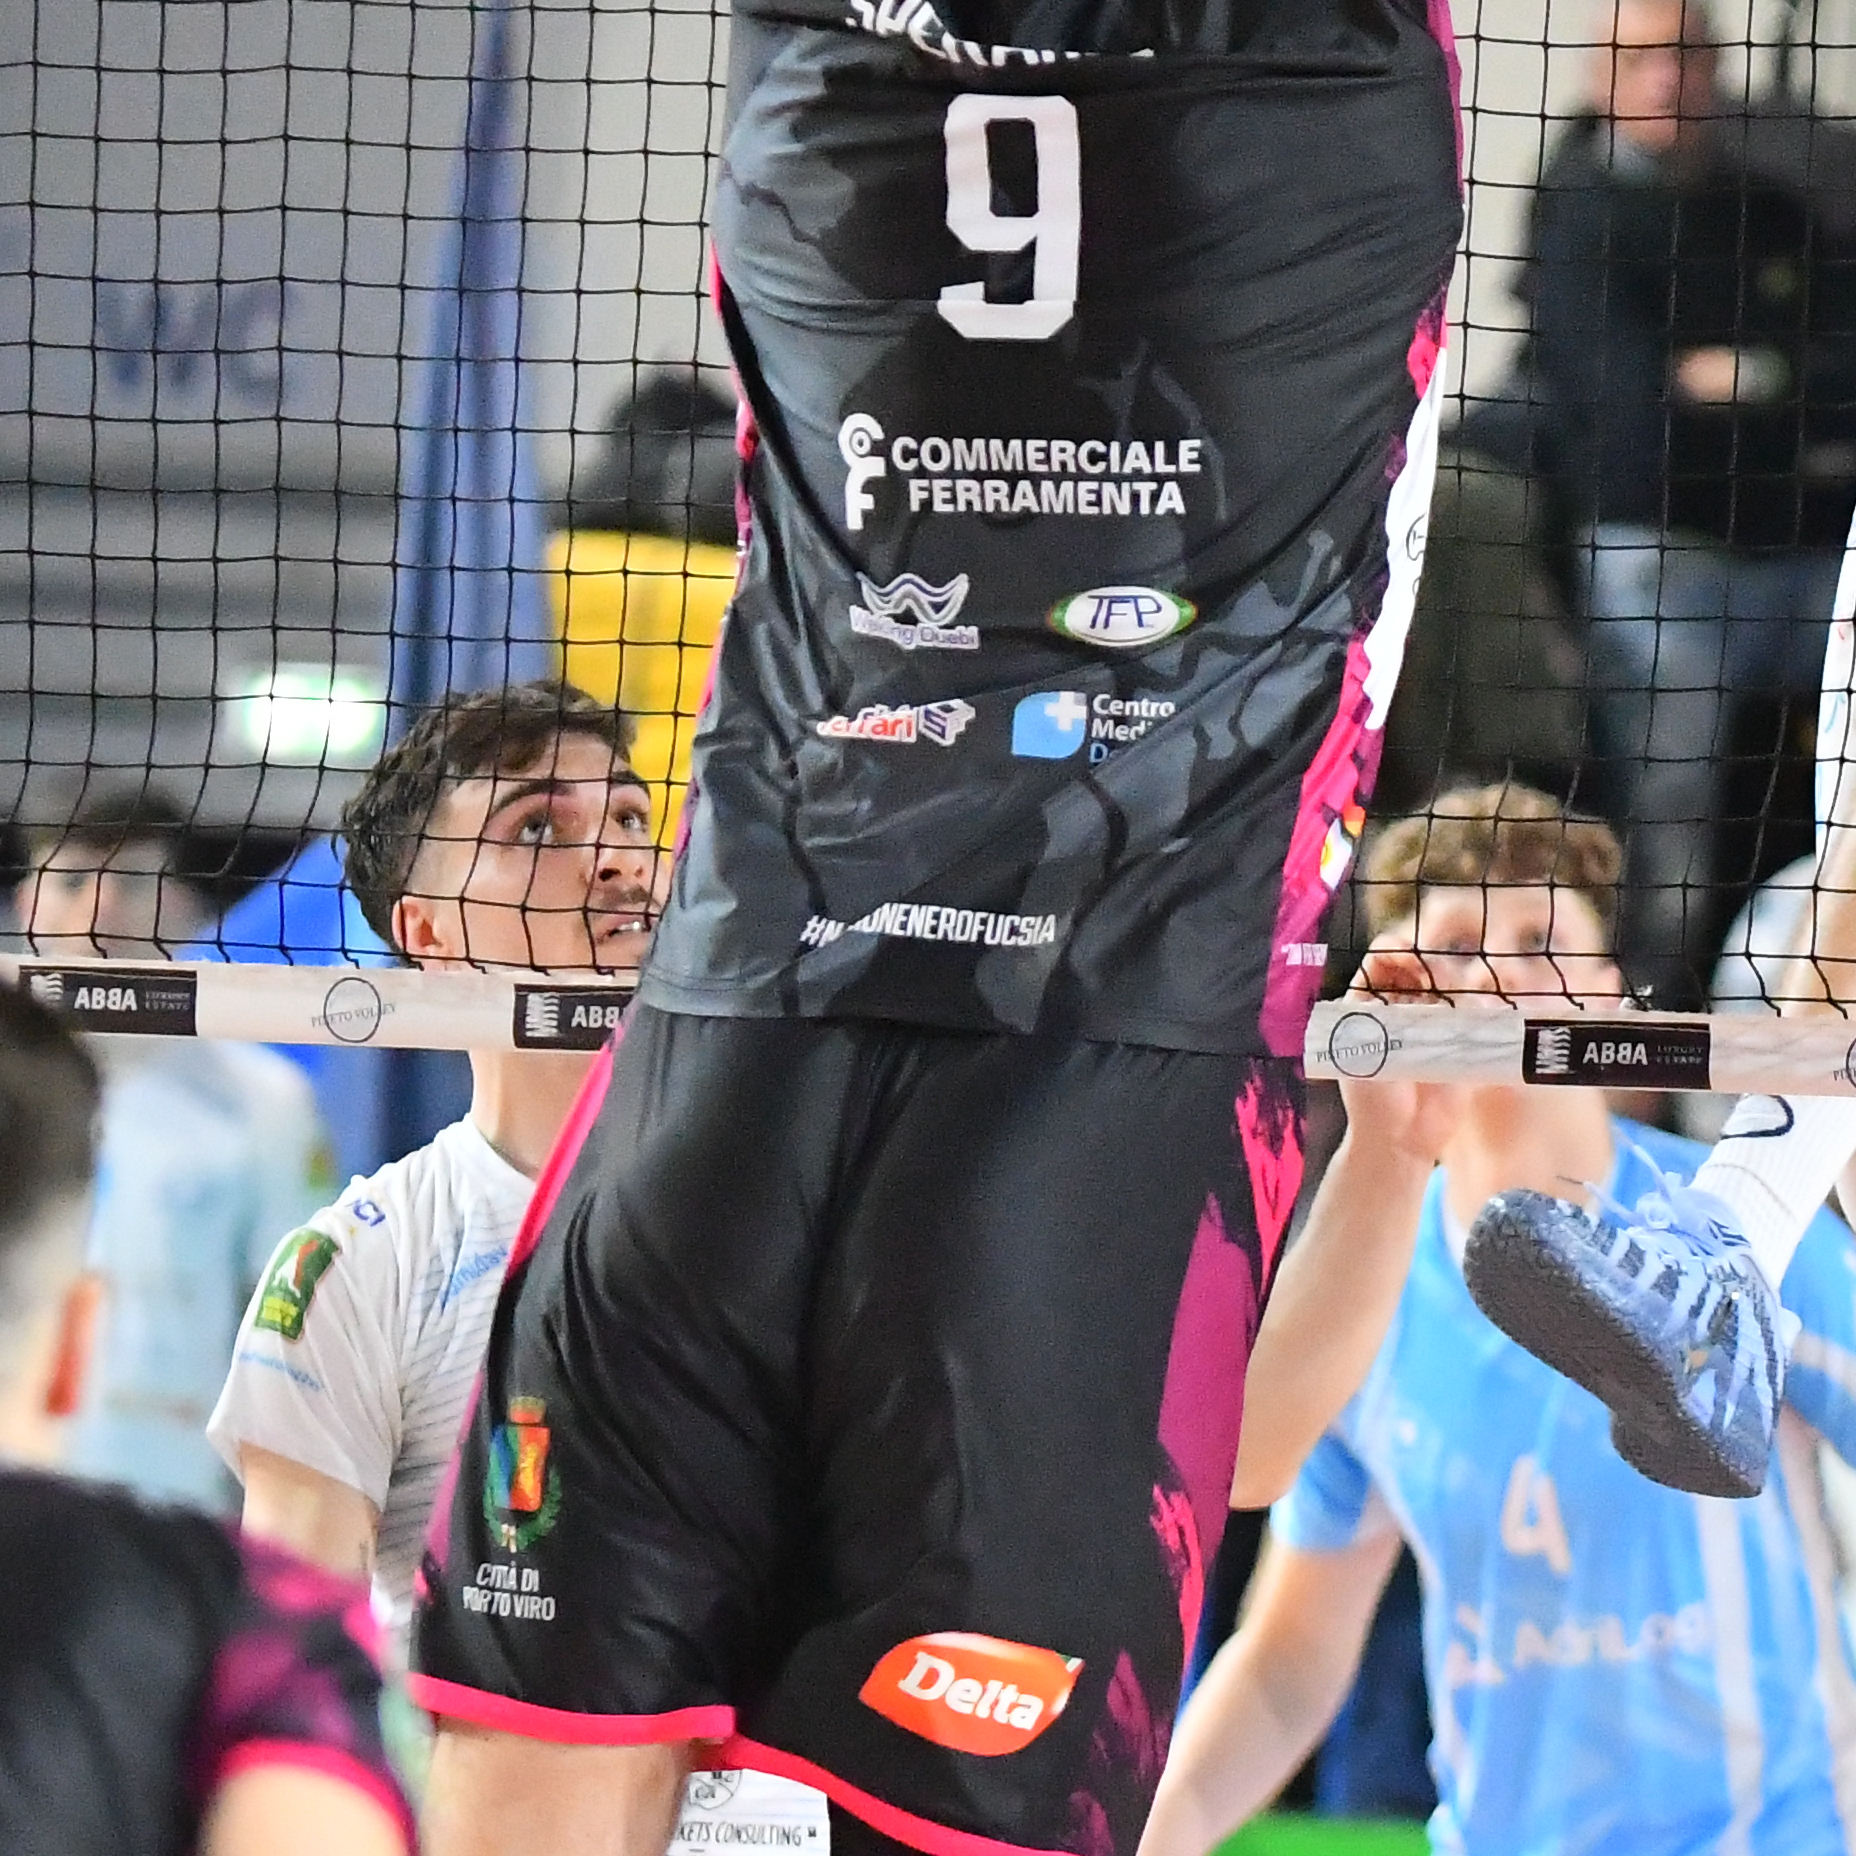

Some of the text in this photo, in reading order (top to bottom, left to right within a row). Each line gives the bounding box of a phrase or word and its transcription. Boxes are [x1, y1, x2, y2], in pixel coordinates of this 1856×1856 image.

[937, 94, 1081, 340] 9
[891, 436, 1201, 474] COMMERCIALE
[909, 478, 1186, 515] FERRAMENTA
[1087, 595, 1163, 630] TFP
[1092, 693, 1176, 718] Centro
[74, 987, 137, 1012] ABBA
[1582, 1041, 1648, 1065] ABBA
[520, 1568, 539, 1592] DI
[462, 1586, 556, 1621] PORTO VIRO
[897, 1651, 1044, 1730] Delta
[715, 1821, 803, 1847] CONSULTING
